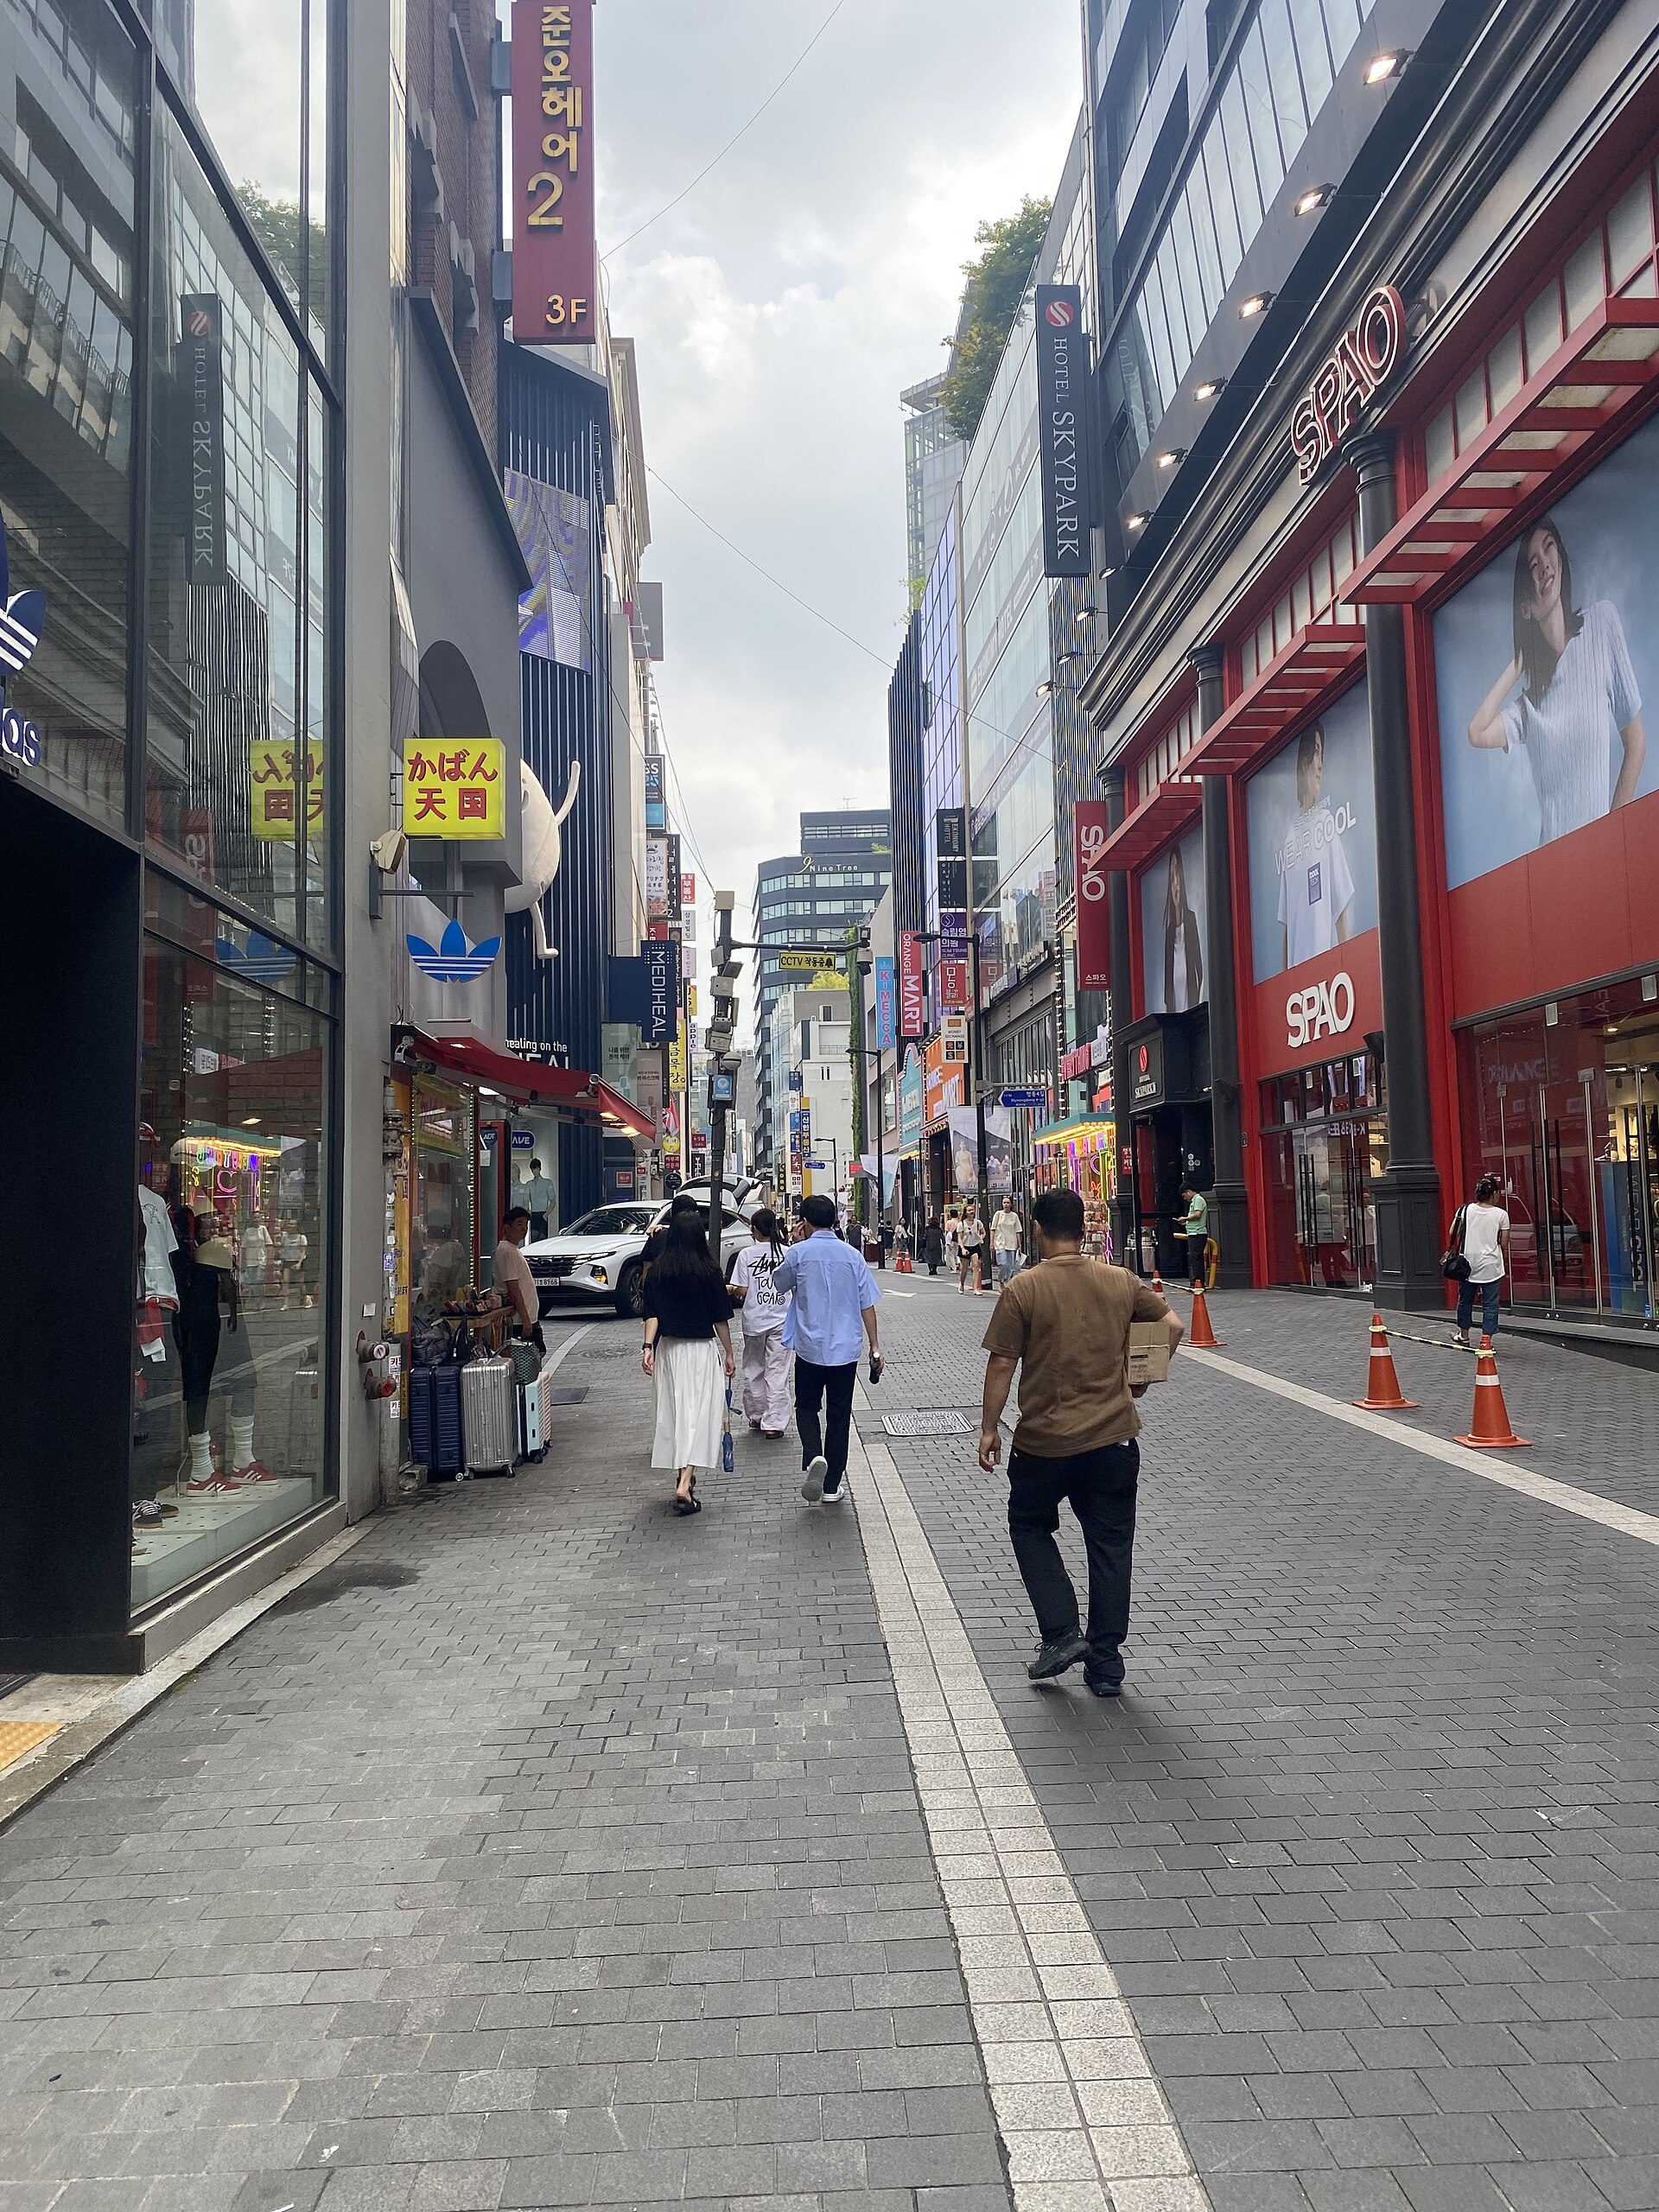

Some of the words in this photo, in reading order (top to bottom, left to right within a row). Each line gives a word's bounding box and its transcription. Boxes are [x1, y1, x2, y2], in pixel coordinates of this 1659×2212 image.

[541, 5, 582, 172] 준오헤어
[527, 171, 563, 226] 2
[545, 294, 587, 324] 3F
[1052, 337, 1069, 404] HOTEL
[1291, 285, 1406, 486] SPAO
[1052, 411, 1079, 561] SKYPARK
[407, 748, 499, 783] かばん
[413, 786, 487, 821] 天国
[1274, 830, 1313, 876] WEAR
[1314, 801, 1357, 849] COOL
[781, 956, 804, 966] CCTV
[804, 957, 826, 967] 작동중
[903, 933, 912, 974] ORANGE
[652, 950, 666, 1038] MEDIHEAL
[904, 975, 921, 1033] MART
[1287, 972, 1356, 1049] SPAO
[540, 1042, 551, 1052] on
[553, 1040, 568, 1052] the
